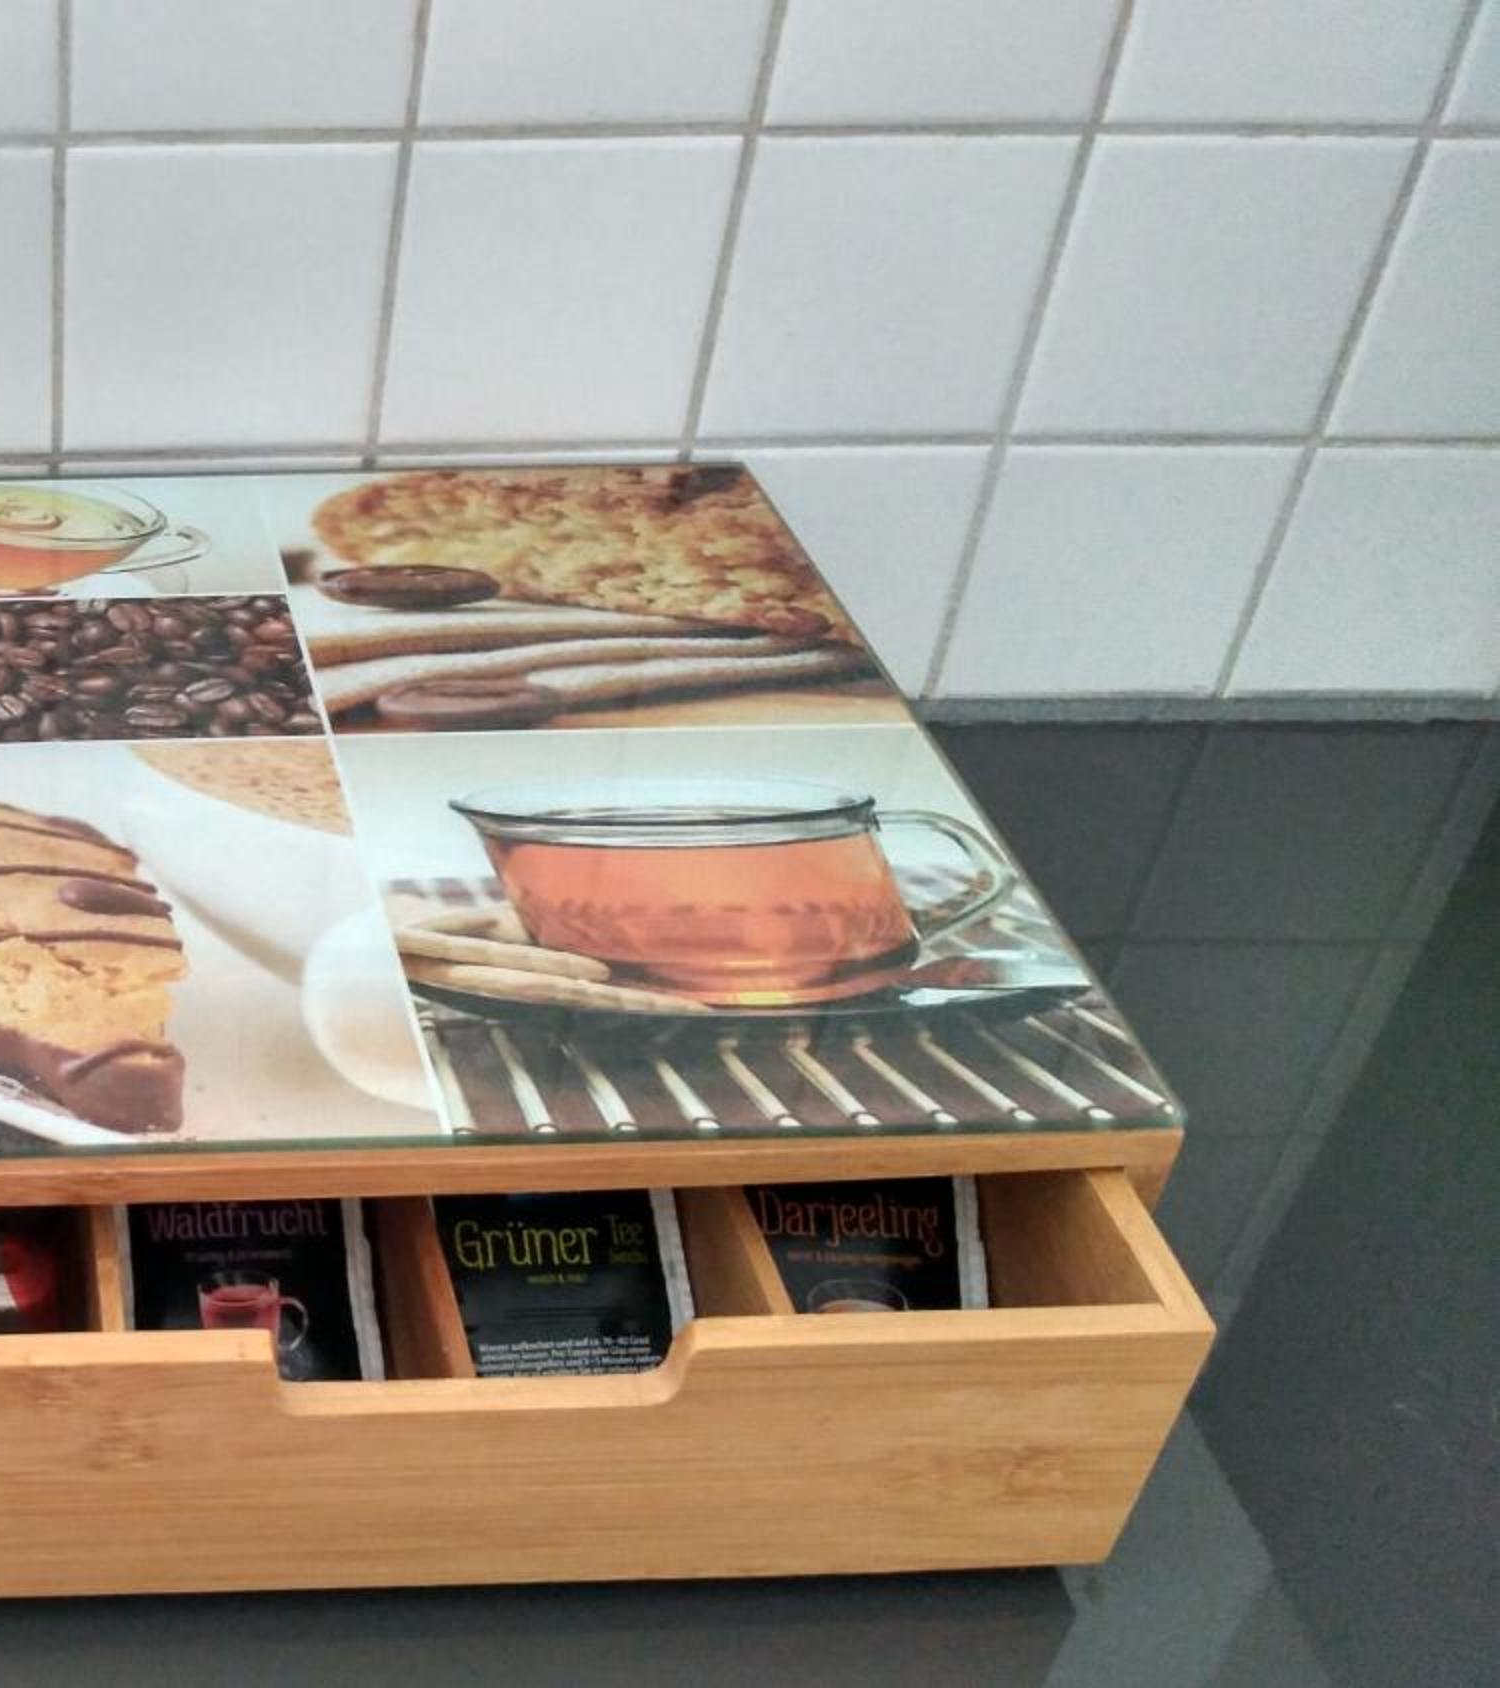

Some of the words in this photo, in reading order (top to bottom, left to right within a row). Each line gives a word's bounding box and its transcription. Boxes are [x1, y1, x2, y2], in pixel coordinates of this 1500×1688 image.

[149, 1198, 328, 1241] Waldfrucht
[454, 1219, 597, 1270] Grüner
[605, 1214, 644, 1247] Tee
[758, 1190, 944, 1257] Darjeeling
